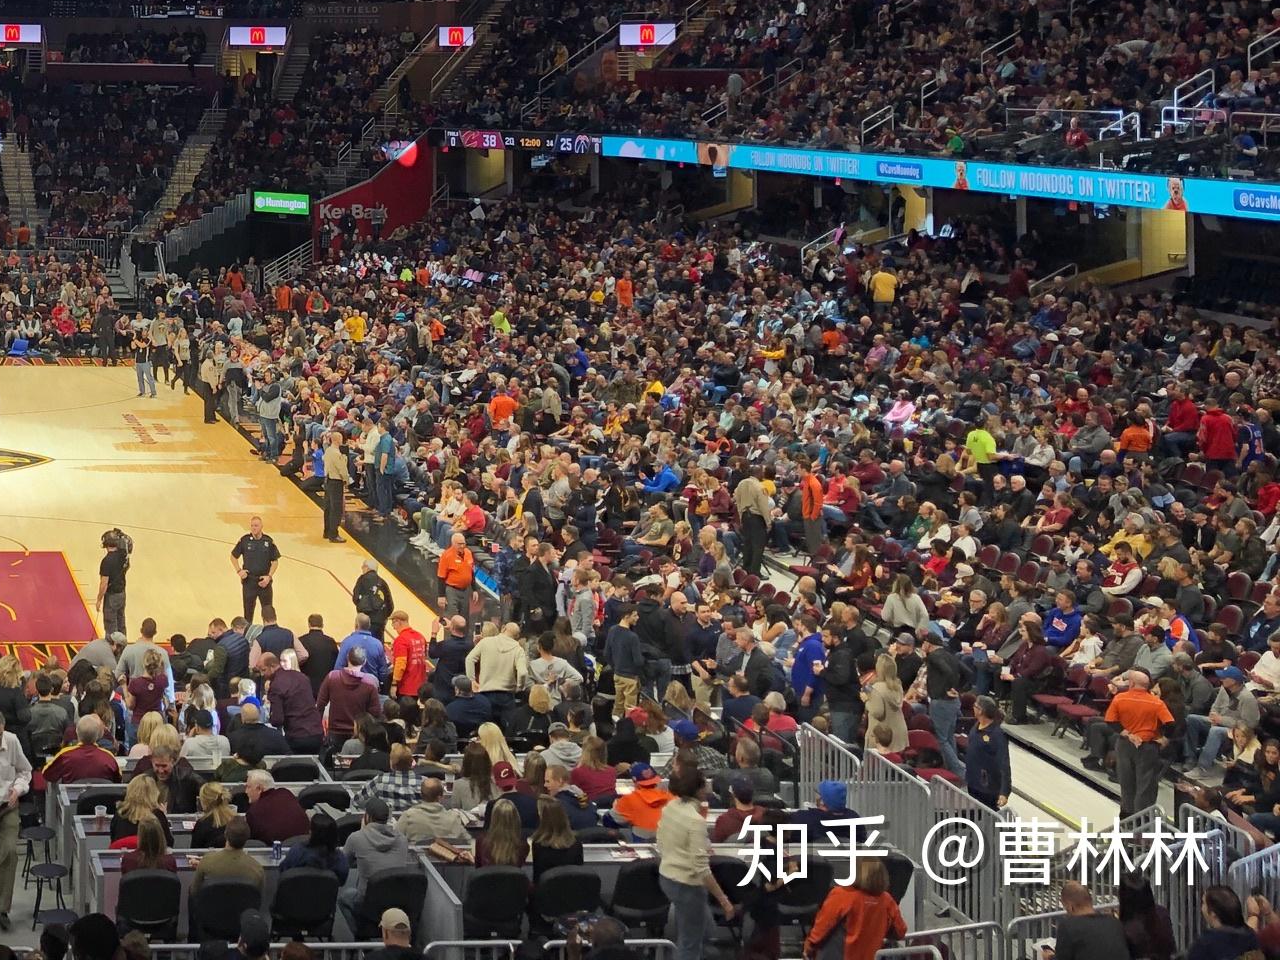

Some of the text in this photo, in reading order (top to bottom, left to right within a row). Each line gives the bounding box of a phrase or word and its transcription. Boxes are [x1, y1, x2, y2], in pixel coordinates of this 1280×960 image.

[450, 137, 456, 147] 0
[482, 134, 497, 147] 38
[519, 138, 541, 148] 12:00
[560, 138, 573, 151] 25
[976, 167, 1016, 190] FOLLOW
[1021, 170, 1074, 194] MOONDOG
[1078, 175, 1094, 197] ON
[1098, 177, 1157, 204] TWITTER!
[265, 196, 307, 211] Huntington
[319, 203, 388, 219] KeBa
